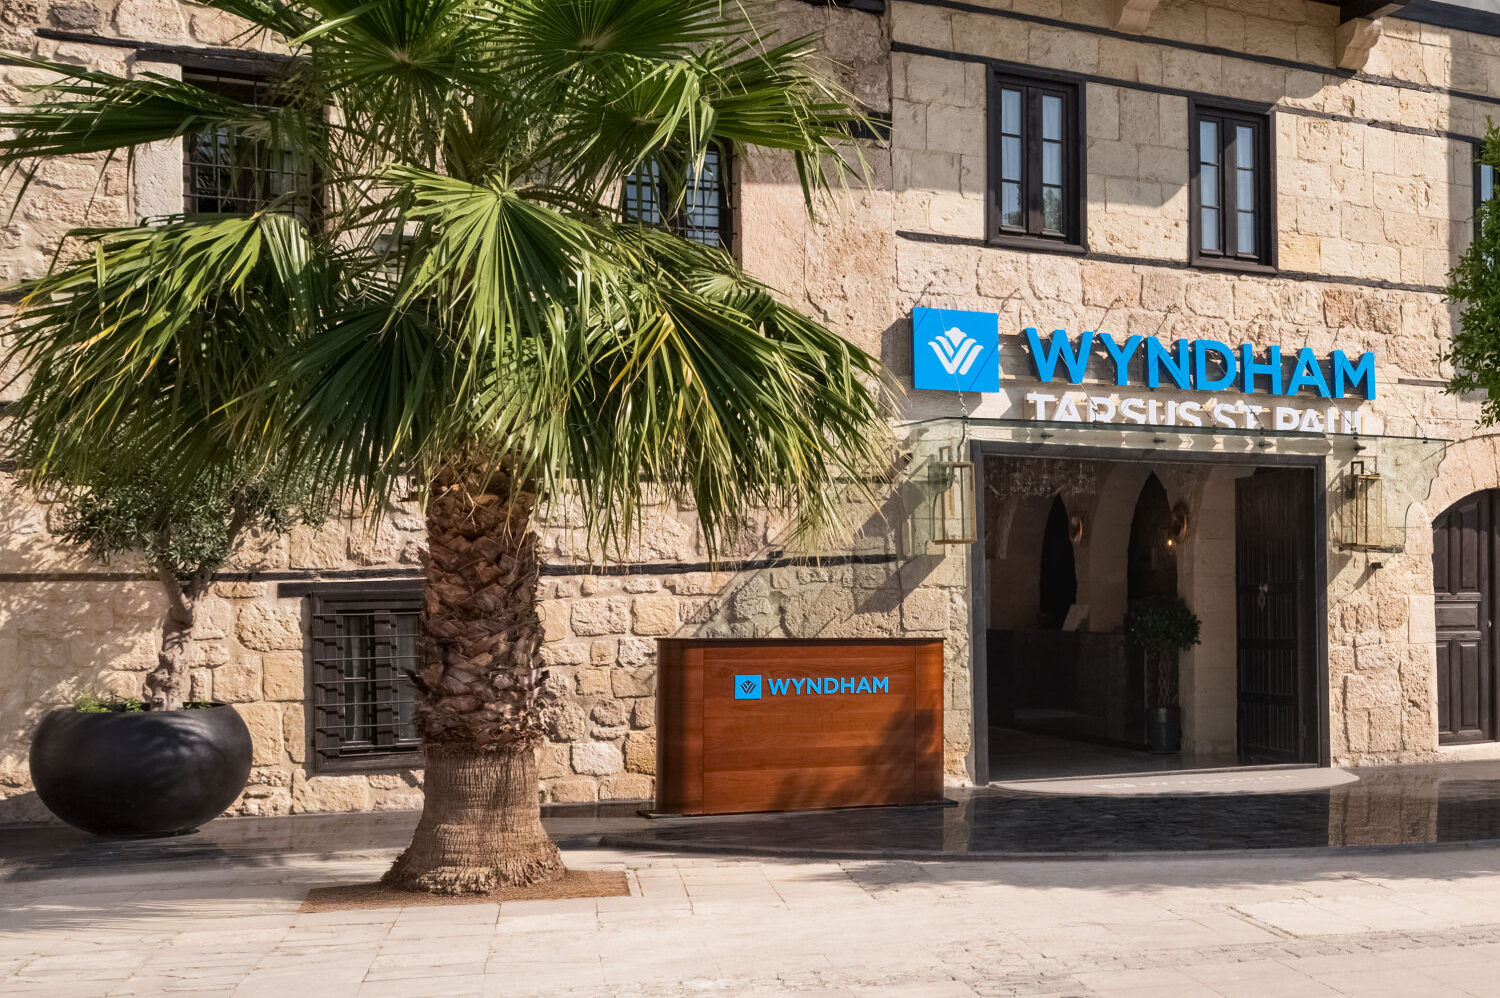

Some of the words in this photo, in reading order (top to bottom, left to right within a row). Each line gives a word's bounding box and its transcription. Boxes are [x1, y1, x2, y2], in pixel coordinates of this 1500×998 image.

[1024, 327, 1376, 401] WYNDHAM
[1026, 392, 1204, 427] TARSUS
[1213, 403, 1263, 430] ST
[767, 676, 889, 696] WYNDHAM
